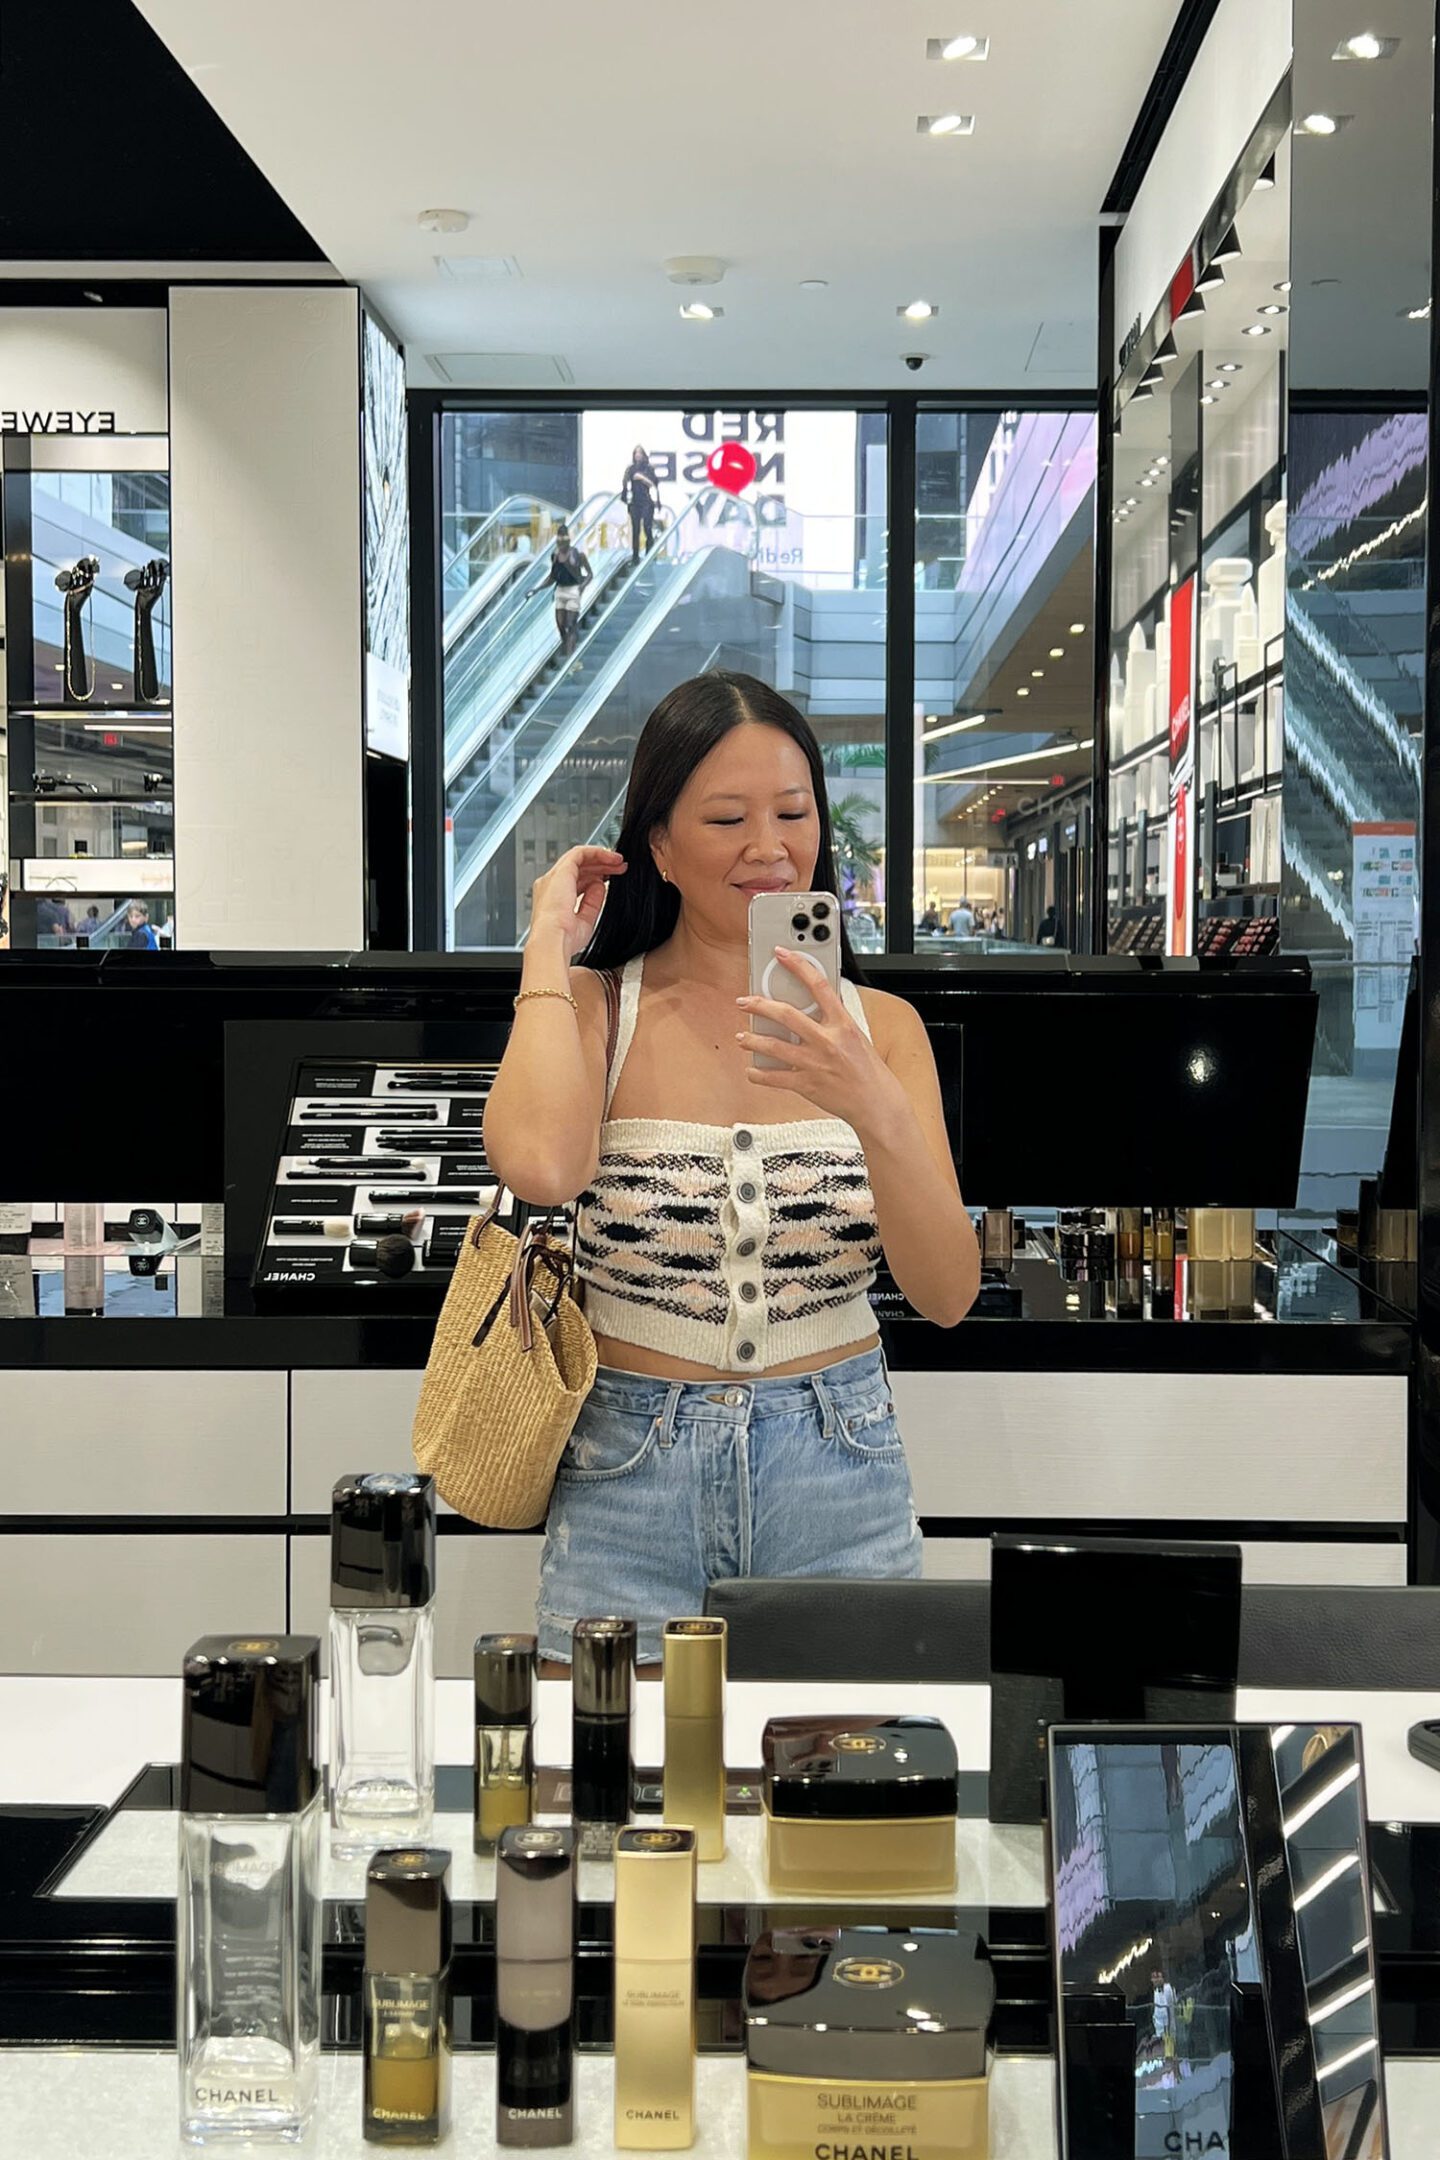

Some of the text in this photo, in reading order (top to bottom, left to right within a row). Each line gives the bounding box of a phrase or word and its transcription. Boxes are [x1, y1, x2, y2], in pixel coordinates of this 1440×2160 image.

[195, 2087, 280, 2104] CHANEL
[817, 2092, 917, 2111] SUBLIMAGE
[507, 2108, 563, 2120] CHANEL
[625, 2109, 680, 2121] CHANEL
[837, 2112, 852, 2123] LA
[814, 2143, 920, 2160] CHANEL
